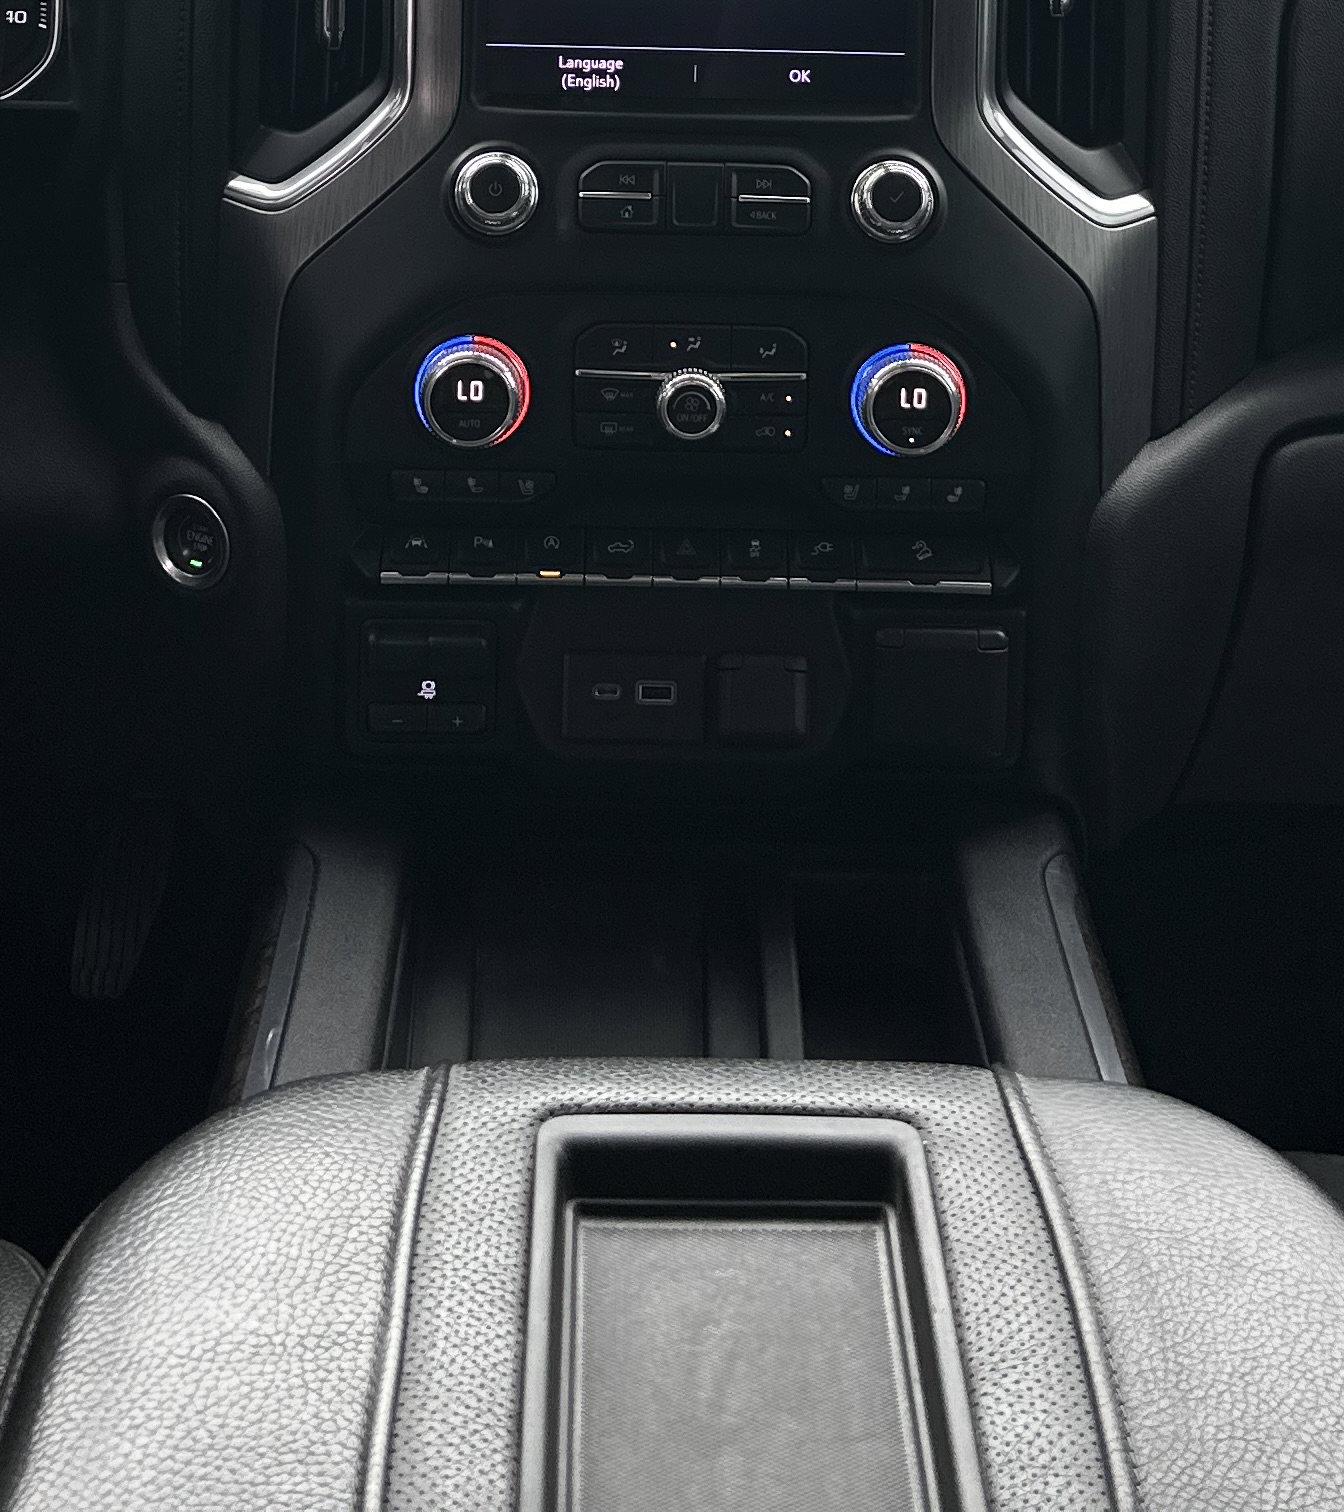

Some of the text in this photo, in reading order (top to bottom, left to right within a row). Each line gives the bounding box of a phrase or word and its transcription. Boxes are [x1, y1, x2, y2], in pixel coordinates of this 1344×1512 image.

[558, 55, 624, 73] Language
[561, 74, 621, 92] (English)
[788, 69, 811, 83] OK
[756, 210, 777, 221] BACK
[457, 379, 484, 401] LO
[759, 392, 775, 403] A/C
[900, 387, 927, 409] LO
[458, 419, 481, 428] AUTO
[676, 413, 708, 423] ON/OFF
